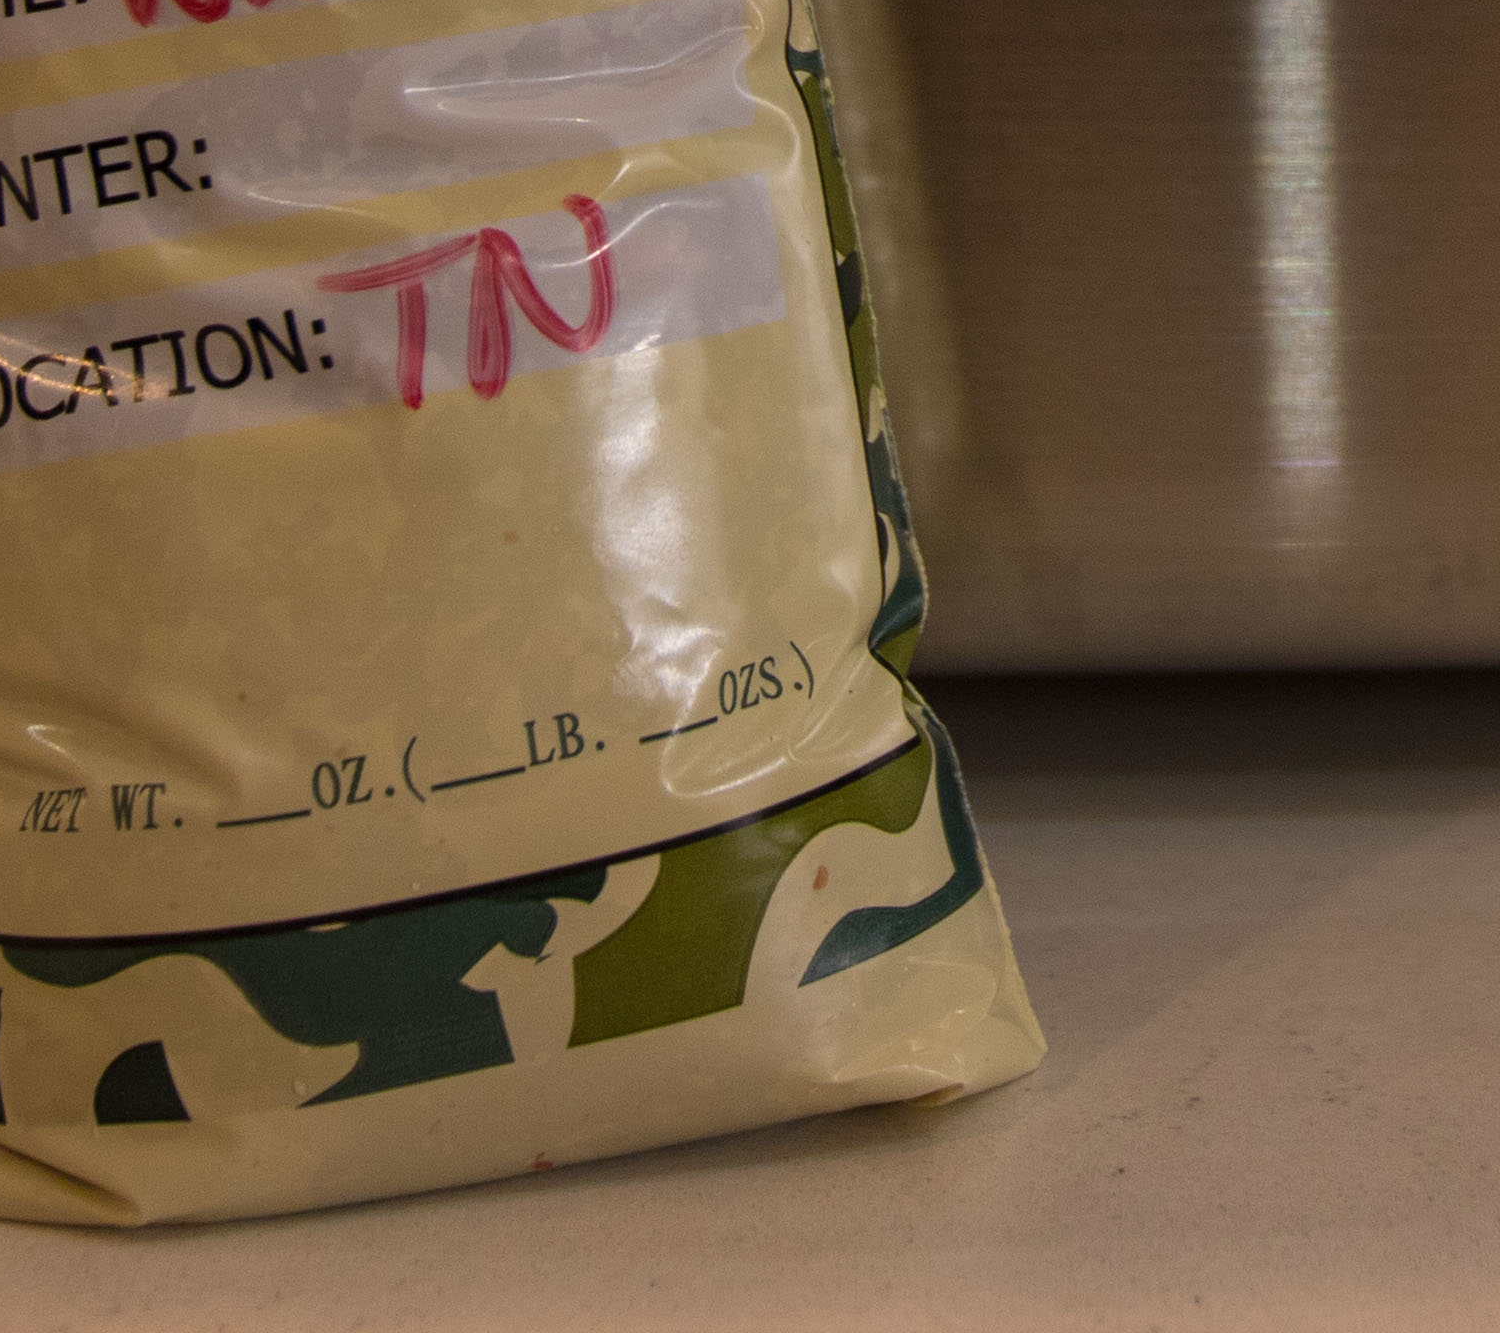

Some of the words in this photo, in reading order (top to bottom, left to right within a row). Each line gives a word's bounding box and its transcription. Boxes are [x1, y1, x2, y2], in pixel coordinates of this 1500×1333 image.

[315, 194, 619, 410] TN
[18, 787, 89, 834] NET
[109, 783, 185, 833] WT.
